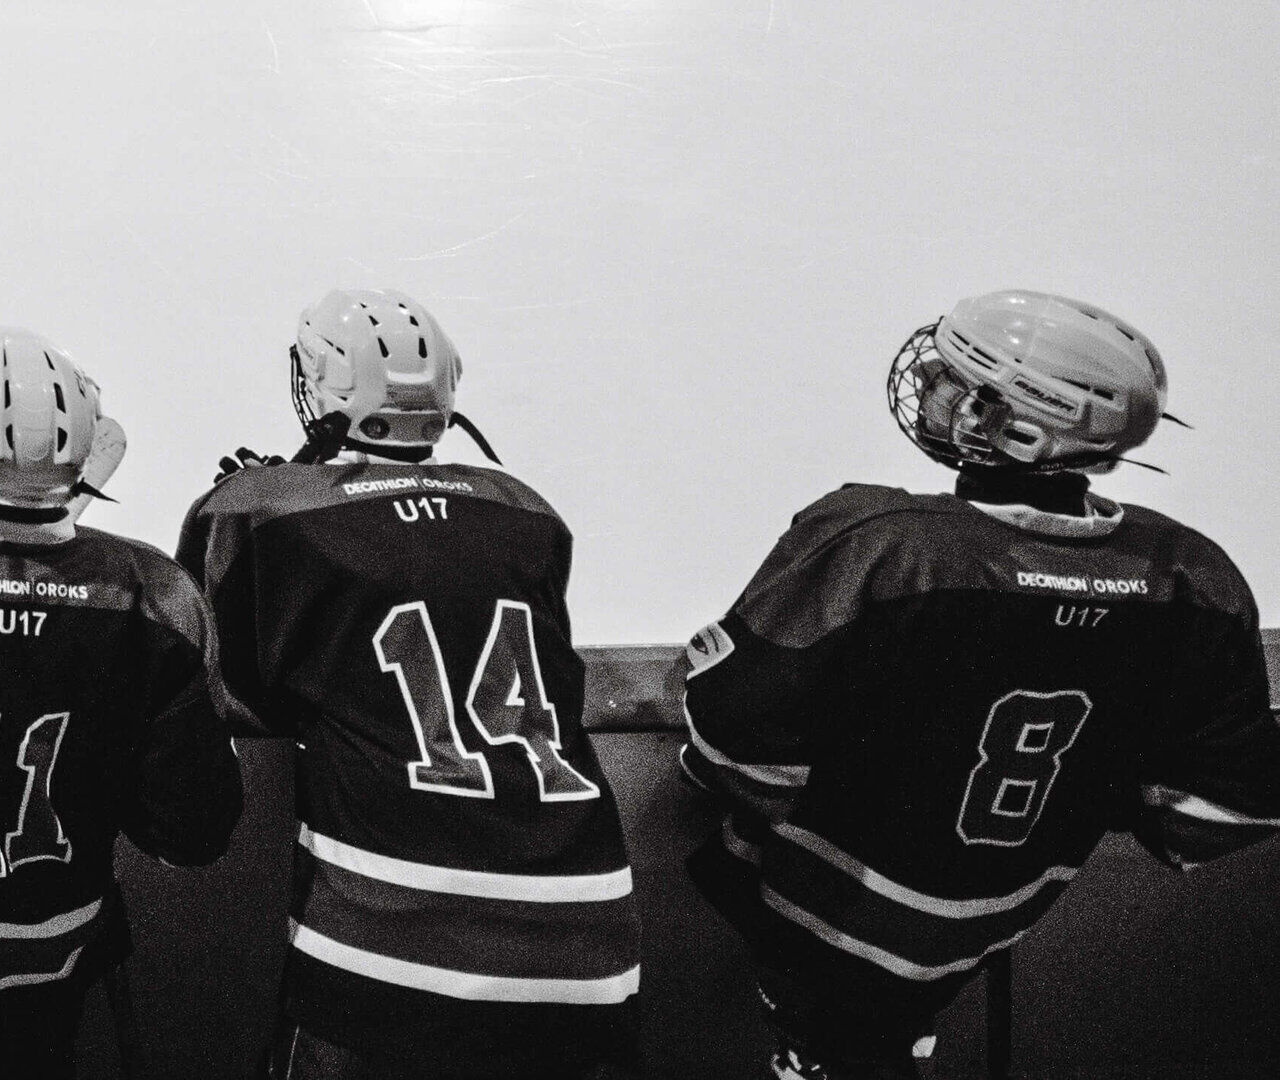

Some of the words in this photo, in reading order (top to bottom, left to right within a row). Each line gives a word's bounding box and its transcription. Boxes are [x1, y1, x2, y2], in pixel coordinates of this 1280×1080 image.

[343, 478, 419, 495] DECATHLON
[393, 497, 448, 522] U17
[36, 582, 89, 599] OROKS
[1017, 572, 1089, 591] DECATHLON
[1093, 579, 1149, 594] OROKS
[1055, 604, 1110, 627] U17
[370, 598, 601, 803] 14
[954, 688, 1094, 848] 8
